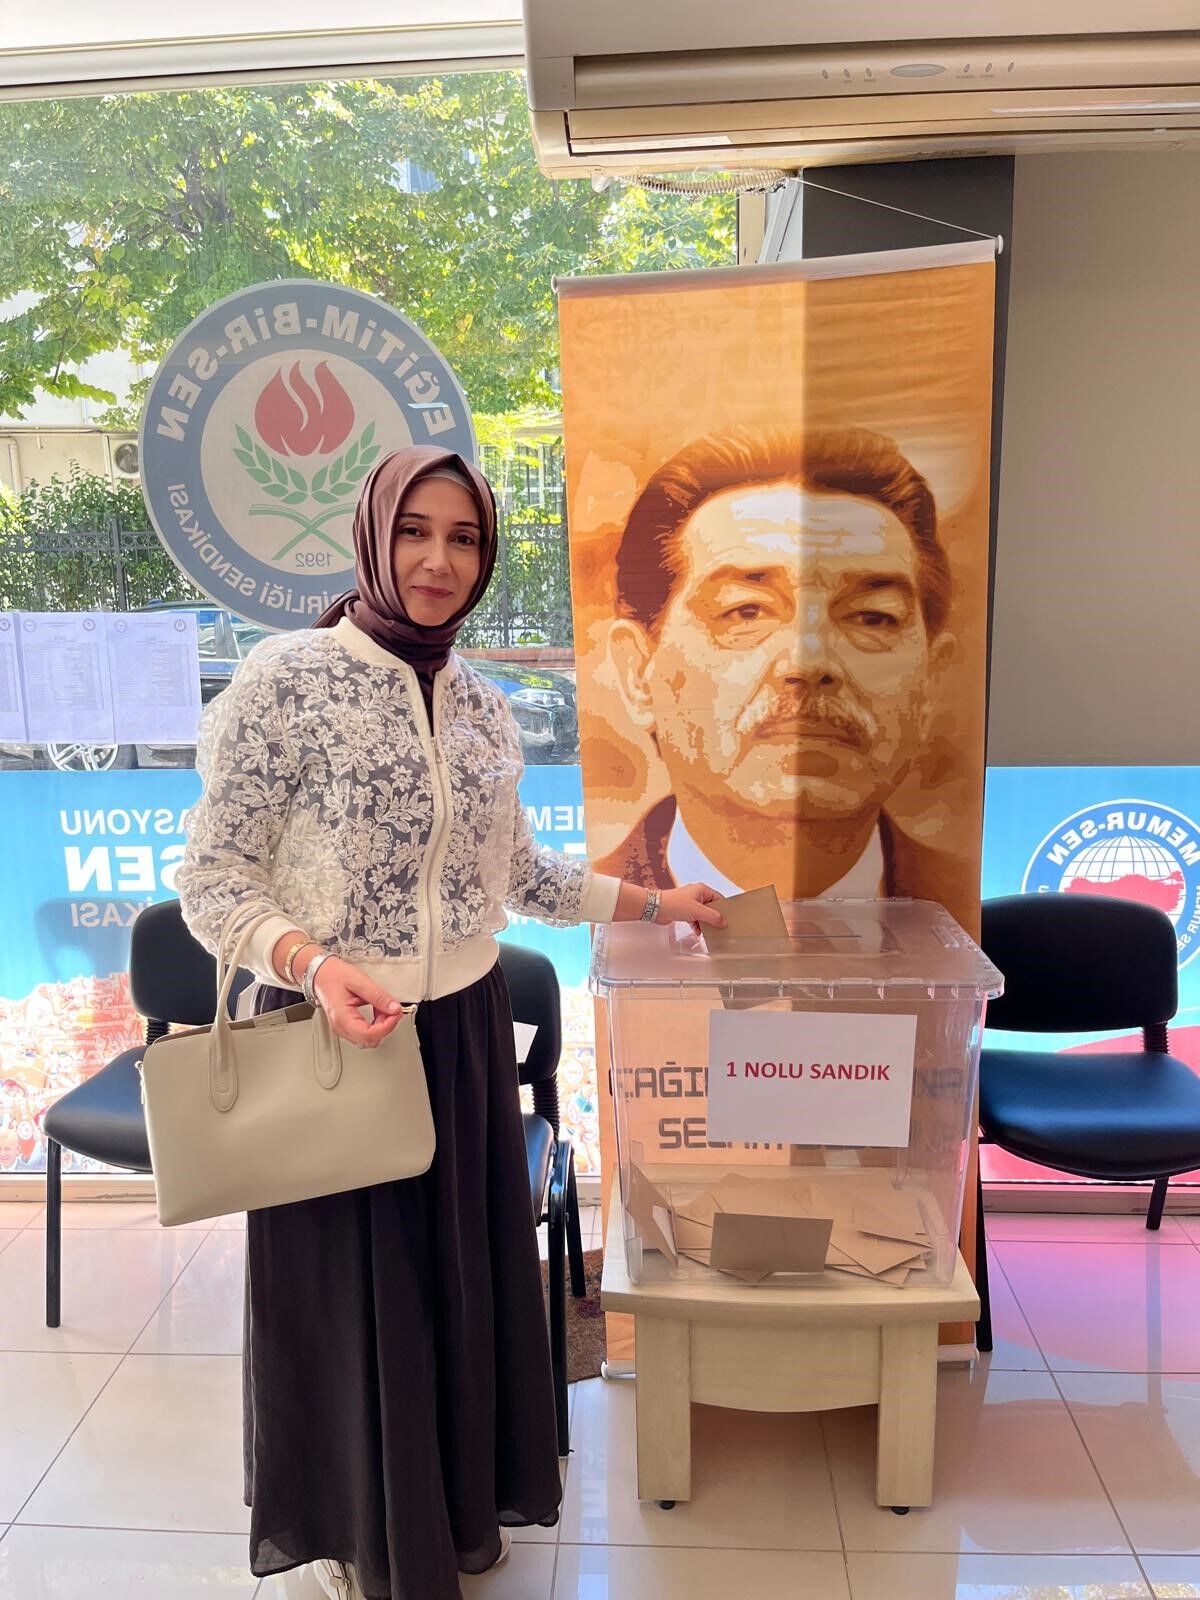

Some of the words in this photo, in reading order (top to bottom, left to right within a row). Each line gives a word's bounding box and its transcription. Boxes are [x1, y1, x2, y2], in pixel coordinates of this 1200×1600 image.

[726, 1061, 737, 1078] 1
[744, 1061, 803, 1079] NOLU
[809, 1062, 891, 1081] SANDIK
